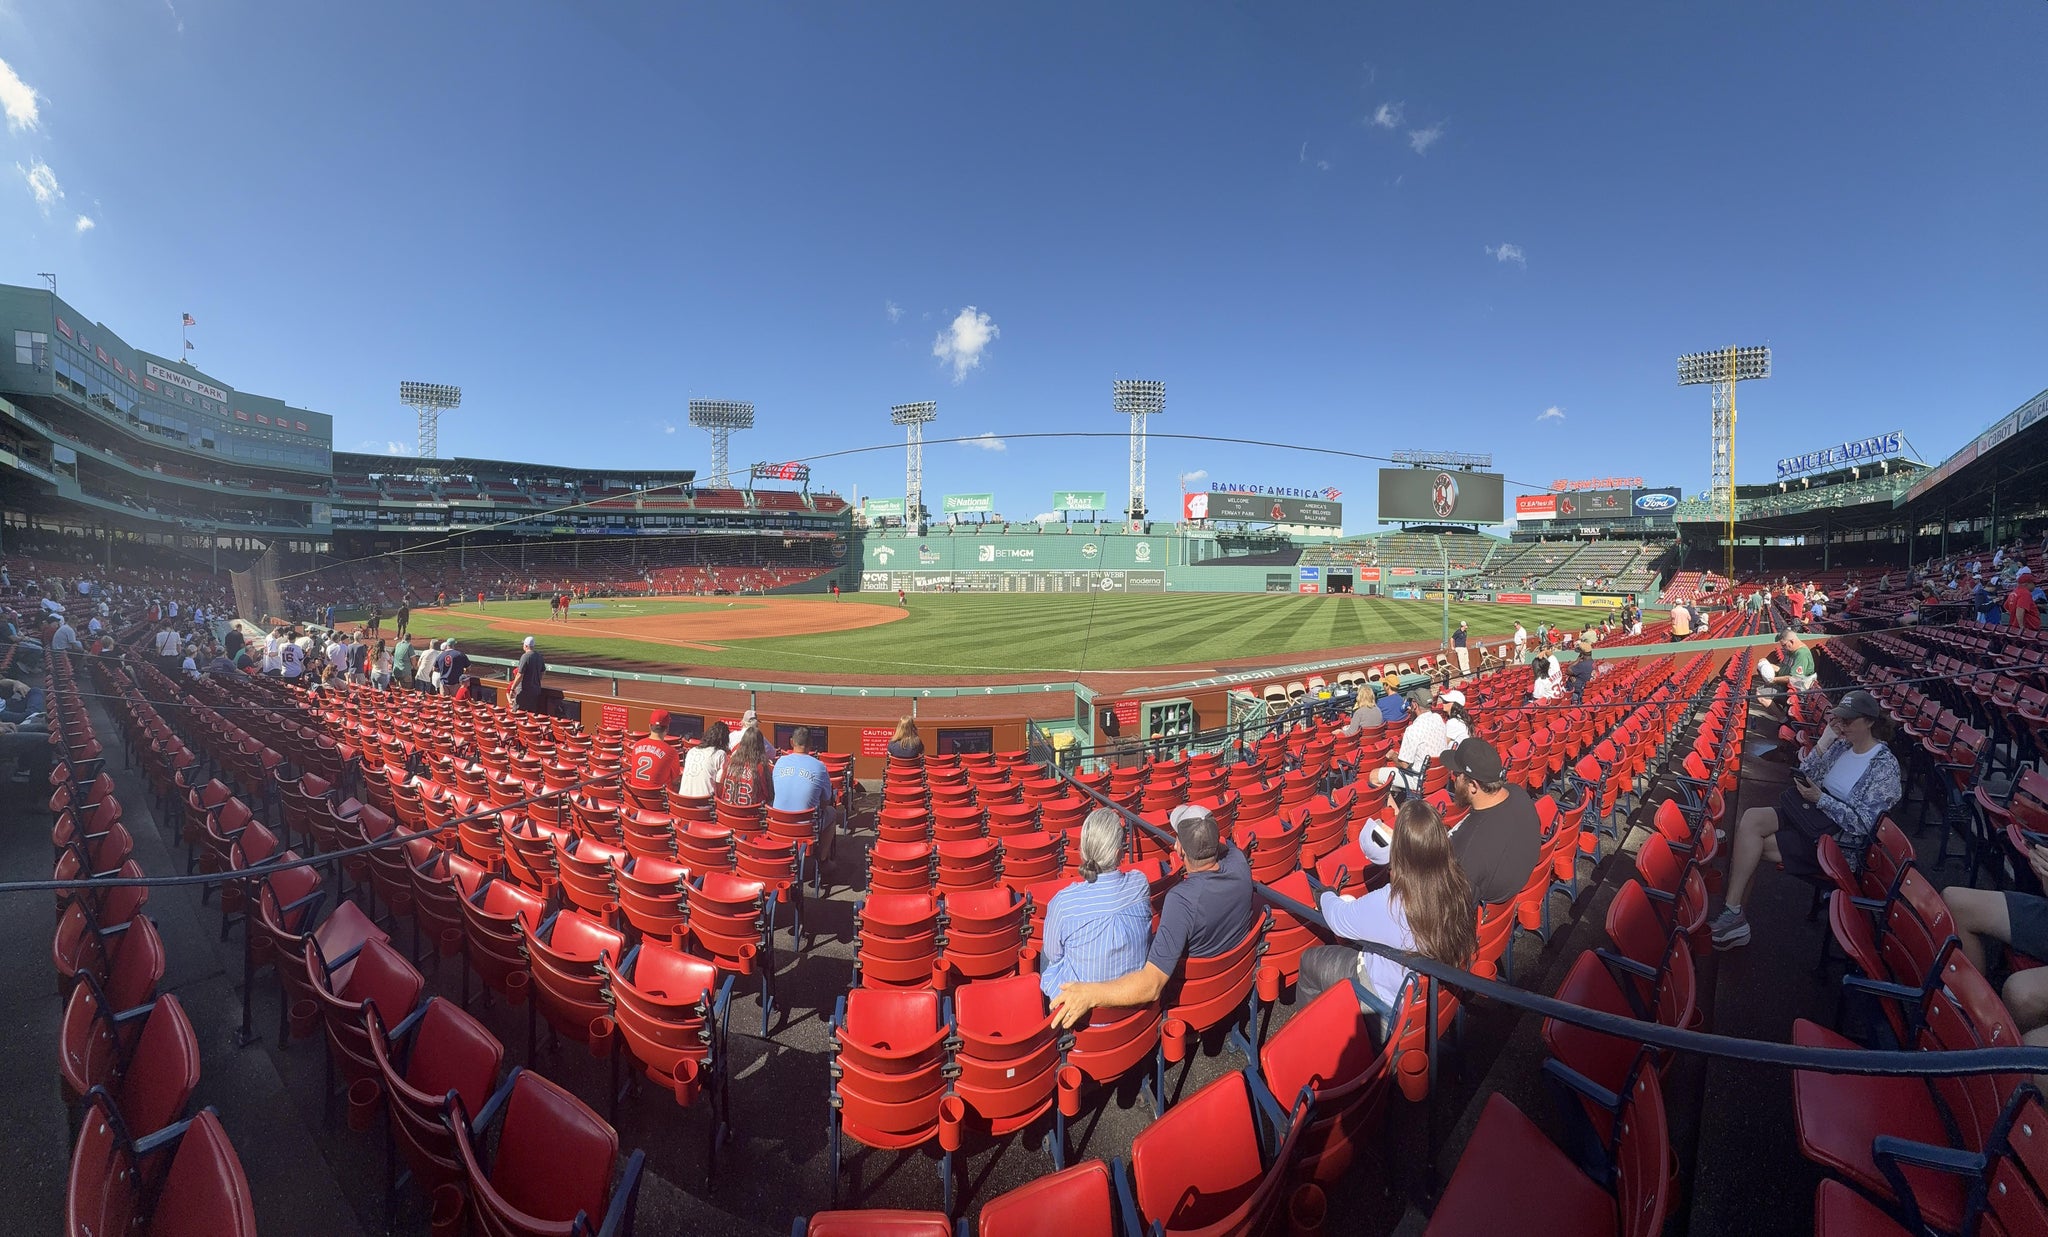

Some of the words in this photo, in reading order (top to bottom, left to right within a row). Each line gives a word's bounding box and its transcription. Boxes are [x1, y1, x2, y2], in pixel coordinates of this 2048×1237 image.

[152, 366, 192, 387] FENWAY
[197, 384, 222, 399] PARK
[1777, 449, 1835, 479] SAMUEL
[1836, 431, 1901, 459] ADAMS
[1212, 482, 1245, 493] BANK
[1250, 485, 1264, 494] OF
[1267, 486, 1319, 499] AMERICA
[956, 497, 989, 506] National
[1643, 496, 1669, 509] Ford
[995, 549, 1034, 558] BETMGM
[871, 573, 888, 581] CVS
[864, 581, 888, 590] Health
[282, 653, 294, 662] 16
[445, 654, 453, 668] 9
[636, 756, 653, 780] 2
[780, 767, 795, 777] RED
[799, 768, 816, 782] SOX
